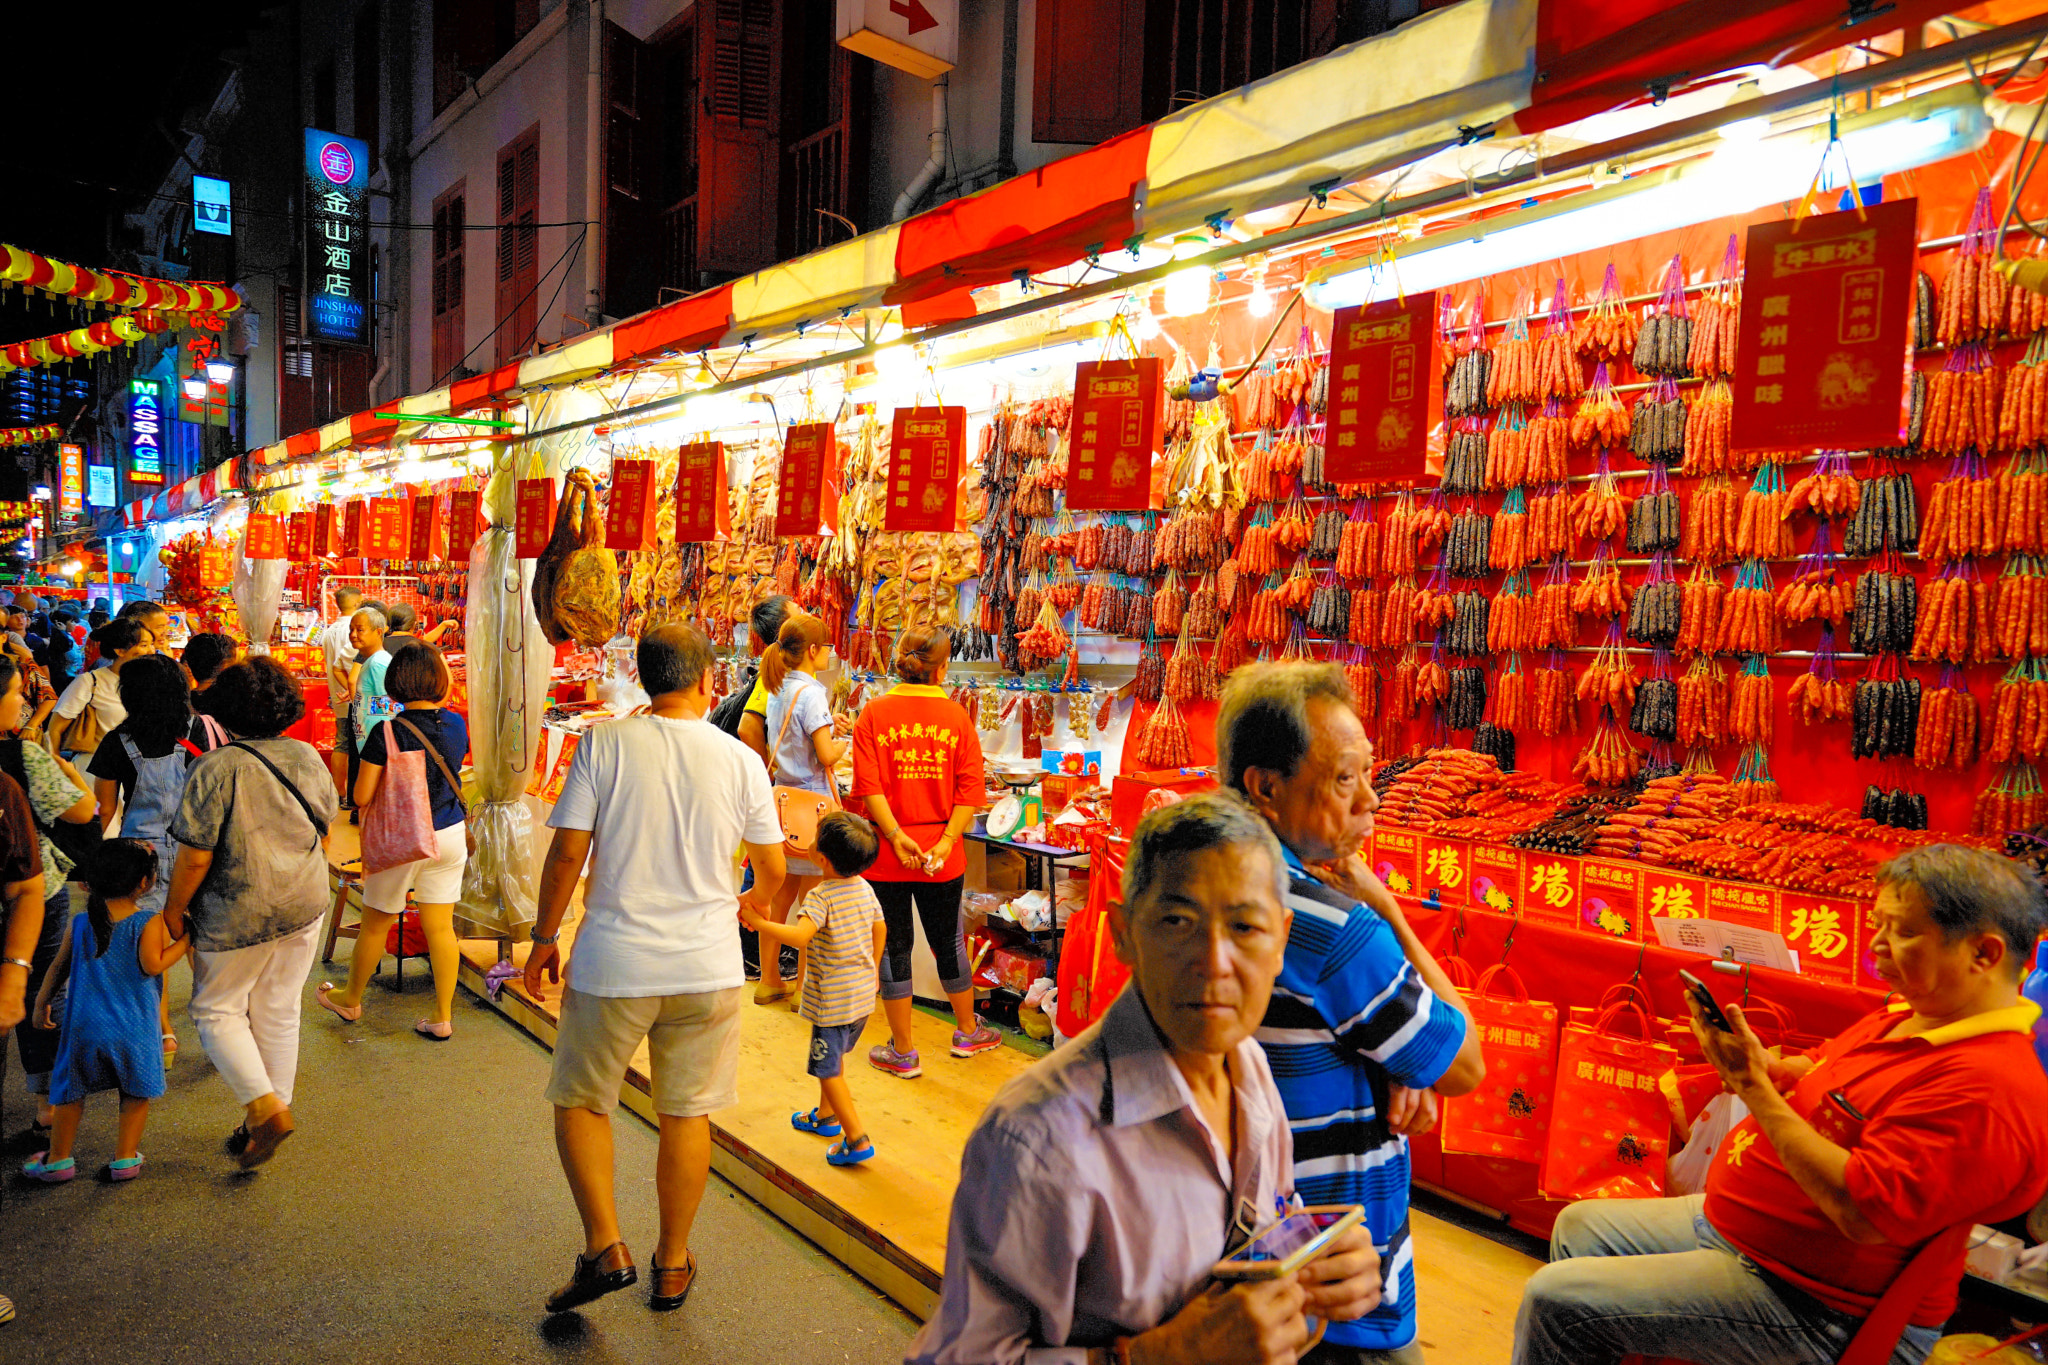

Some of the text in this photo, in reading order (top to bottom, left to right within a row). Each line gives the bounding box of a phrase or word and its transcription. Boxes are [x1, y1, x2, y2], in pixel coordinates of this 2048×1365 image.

[323, 191, 351, 297] 金山酒店
[1786, 241, 1861, 268] 牛車水
[314, 298, 362, 315] JINSHAN
[320, 313, 358, 328] HOTEL
[320, 327, 357, 338] CHINATOWN
[1356, 322, 1403, 343] 牛車水
[1095, 380, 1134, 393] 牛車水
[131, 381, 160, 473] MASSAGE
[1425, 845, 1464, 888] 瑞
[1529, 861, 1574, 908] 瑞
[1649, 882, 1700, 919] 瑞
[1787, 904, 1848, 959] 瑞
[1576, 1060, 1656, 1093] 廣州臘味
